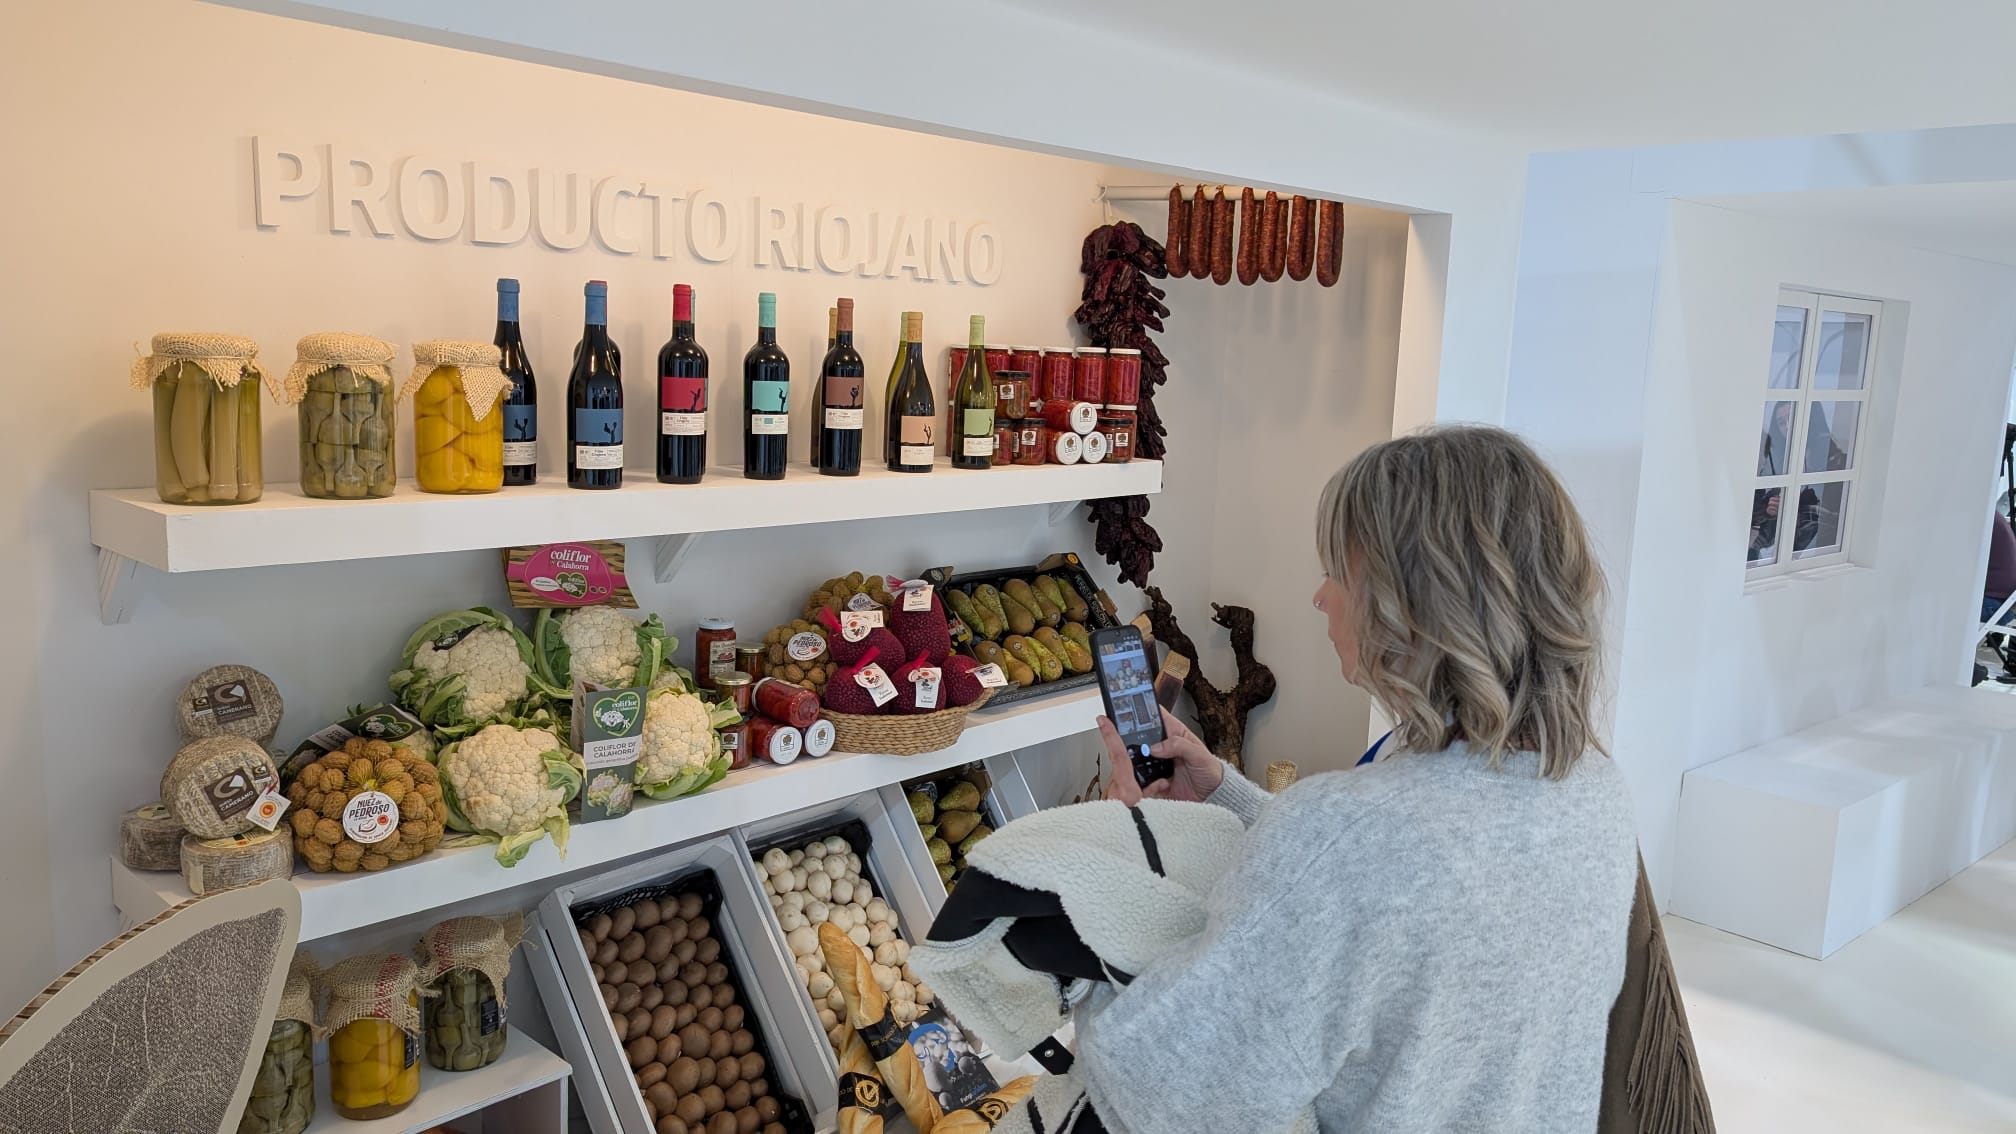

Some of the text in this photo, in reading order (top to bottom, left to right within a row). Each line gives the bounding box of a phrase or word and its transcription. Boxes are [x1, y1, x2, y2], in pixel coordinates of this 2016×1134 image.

[251, 136, 1003, 286] PRODUCTO RIOJANO
[551, 549, 591, 563] coliflor
[556, 560, 589, 571] Calahorra
[217, 704, 252, 715] CAMERANO
[611, 700, 637, 708] coliflor
[593, 743, 627, 752] COLIFLOR
[221, 791, 254, 811] CAMERANO
[357, 798, 376, 808] NUEZ
[349, 803, 390, 819] PEDROSO
